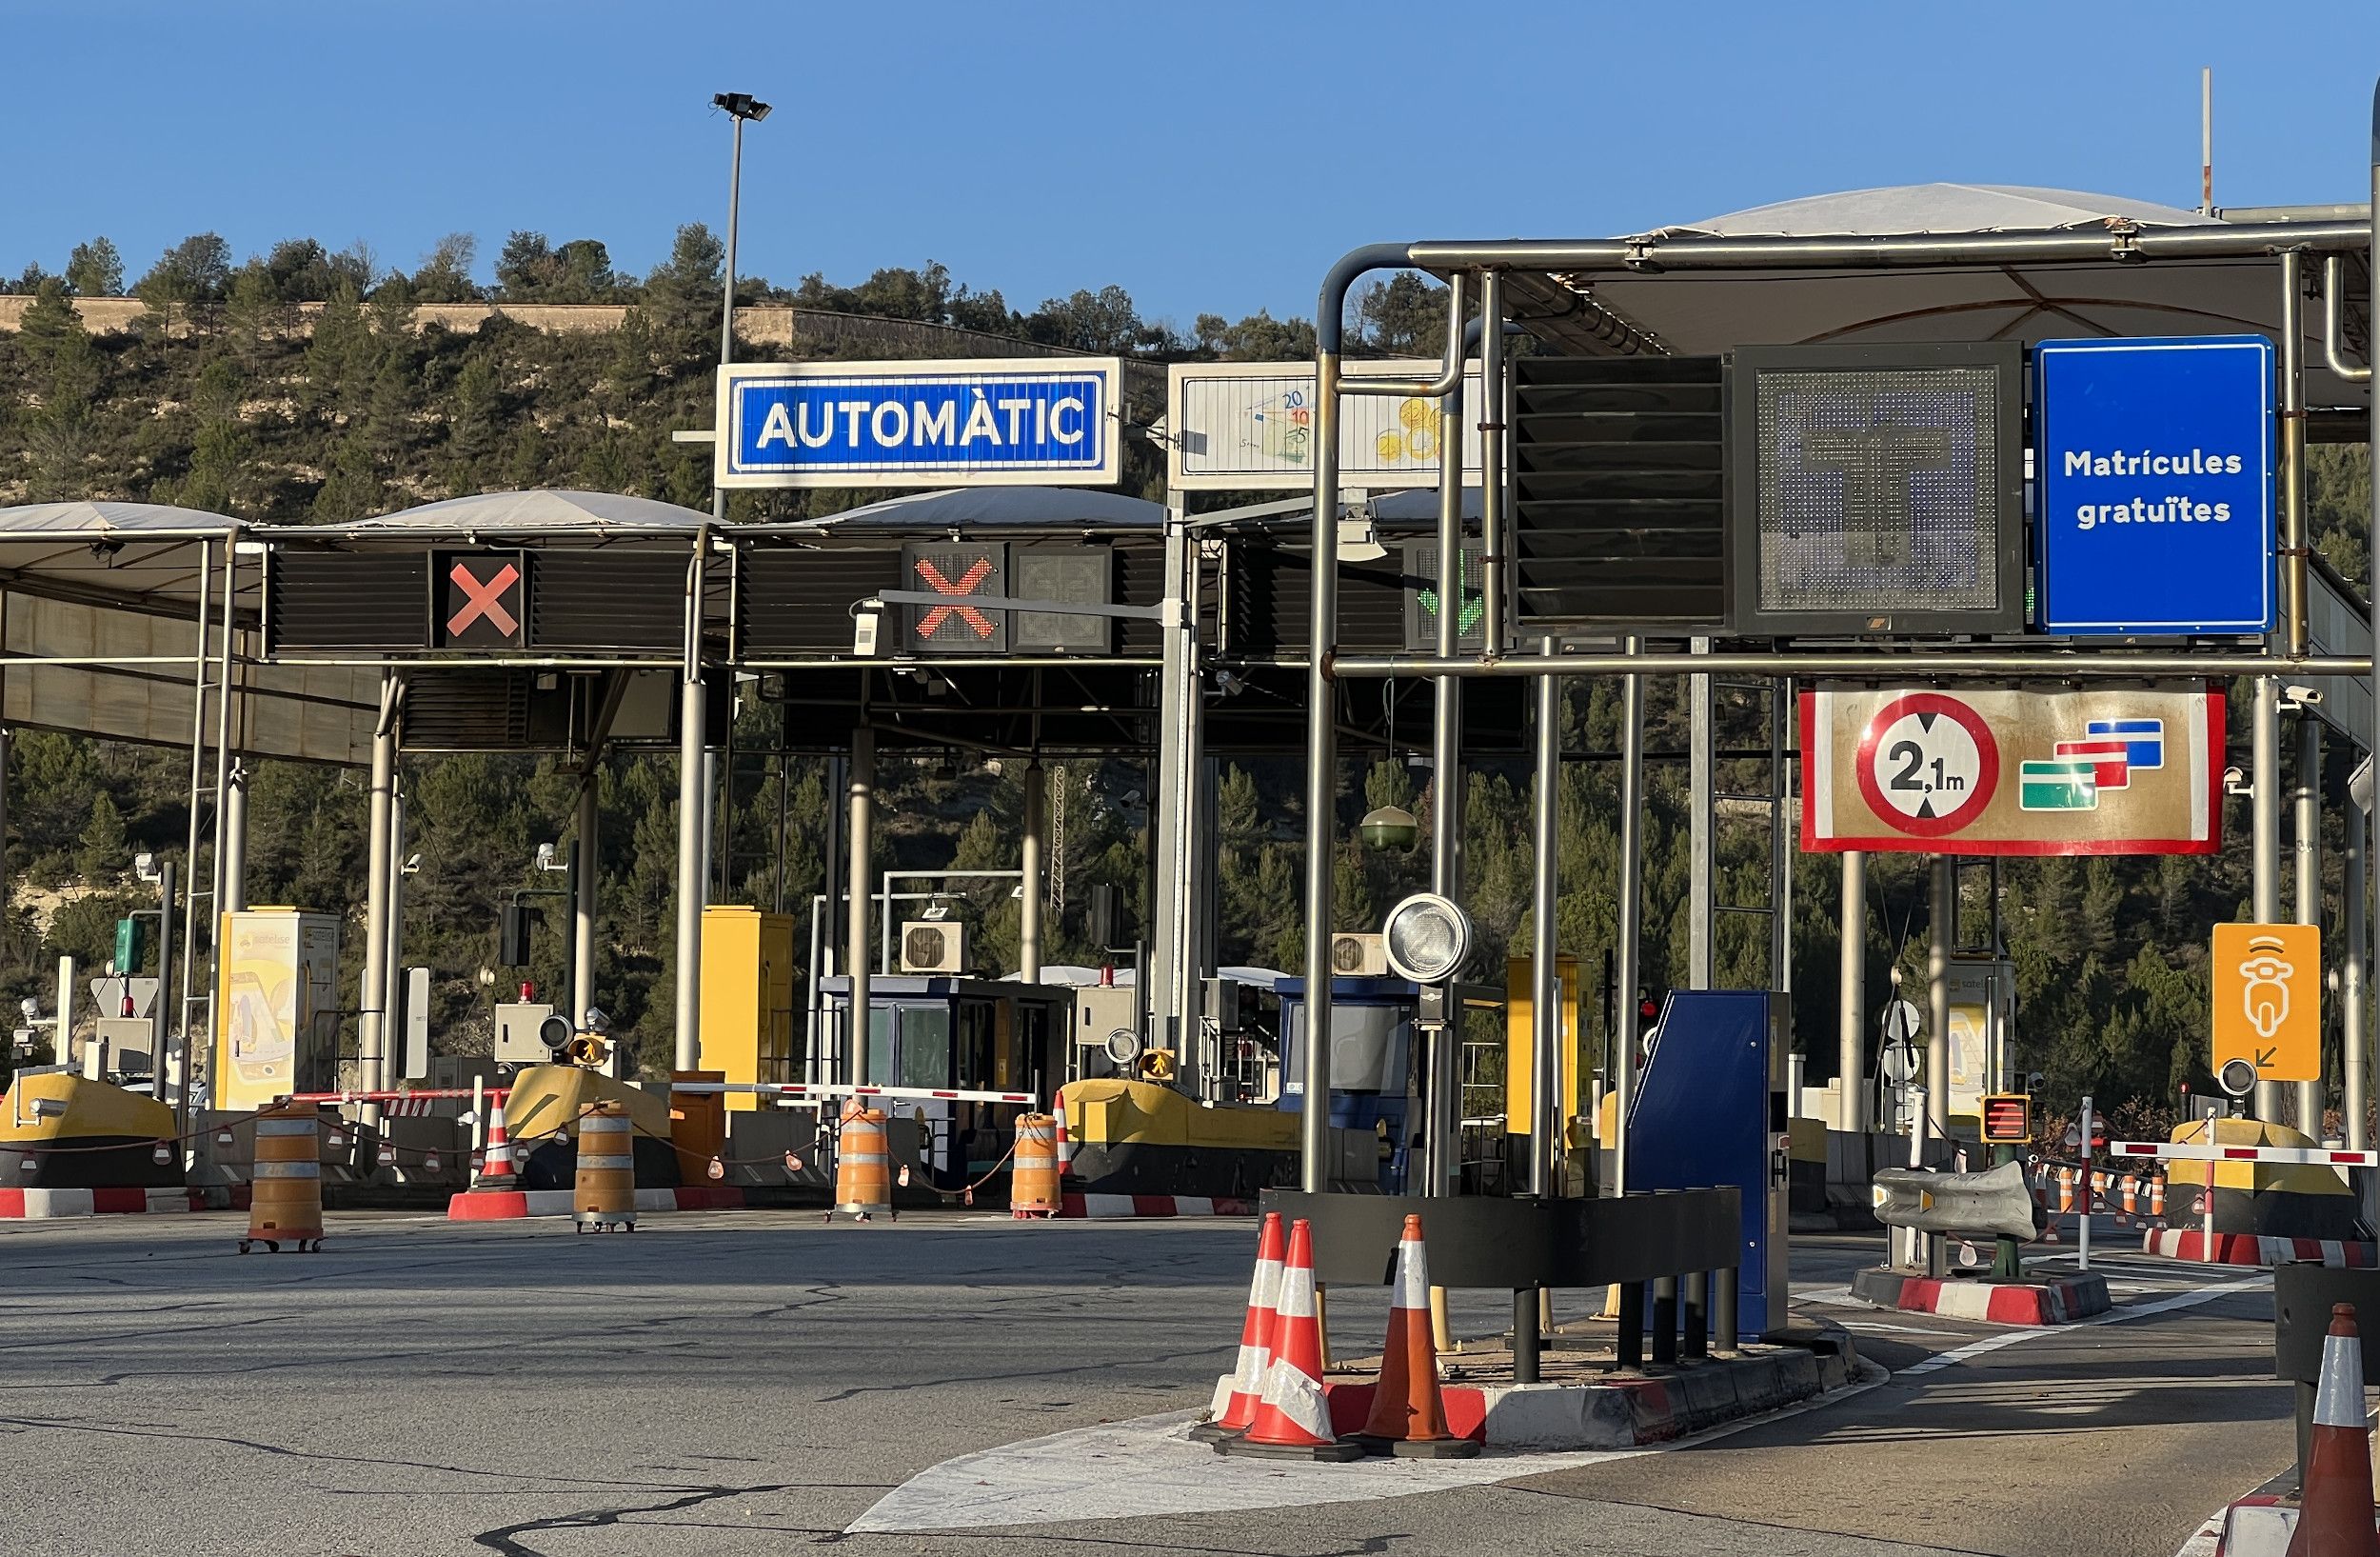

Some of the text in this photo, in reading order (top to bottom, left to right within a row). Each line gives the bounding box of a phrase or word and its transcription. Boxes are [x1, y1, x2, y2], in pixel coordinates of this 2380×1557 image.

[1282, 390, 1303, 409] 20
[756, 388, 1085, 449] AUTOMÀTIC
[1292, 411, 1309, 426] 10
[1298, 427, 1310, 444] 5
[2064, 448, 2242, 476] Matrícules
[2076, 495, 2231, 530] gratuïtes
